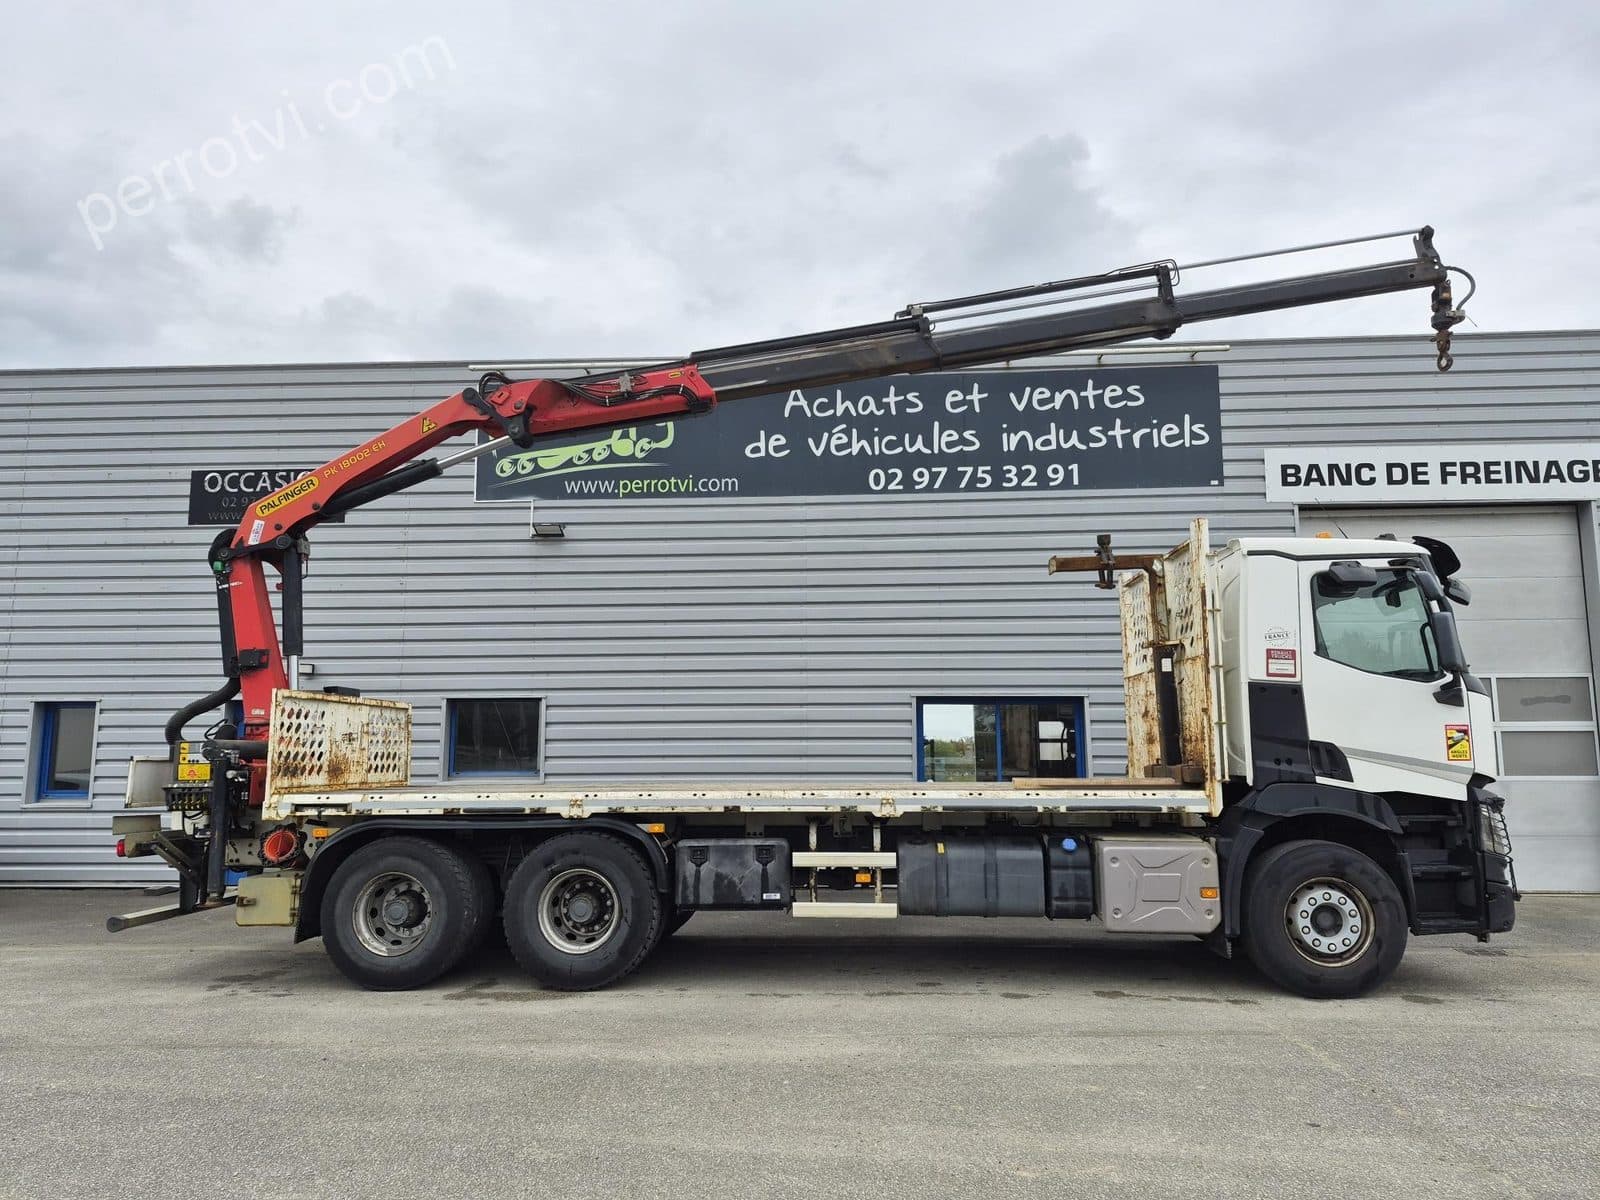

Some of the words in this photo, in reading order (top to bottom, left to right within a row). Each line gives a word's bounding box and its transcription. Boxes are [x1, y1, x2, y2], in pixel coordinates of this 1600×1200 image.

[784, 385, 924, 418] Achats
[945, 383, 989, 413] et
[1009, 379, 1145, 412] ventes
[744, 430, 791, 459] de
[807, 421, 981, 457] véhicules
[1002, 414, 1210, 452] industriels
[323, 465, 338, 479] PK
[339, 448, 371, 470] 18002
[372, 440, 386, 452] EH
[868, 468, 904, 491] 02
[912, 466, 948, 490] 97
[957, 466, 992, 489] 75
[1002, 465, 1038, 488] 32
[1046, 463, 1079, 486] 91
[1280, 463, 1377, 487] BANC
[1386, 462, 1430, 486] DE
[259, 478, 316, 515] PALFINGER
[564, 475, 739, 497] www.perrotvi.com
